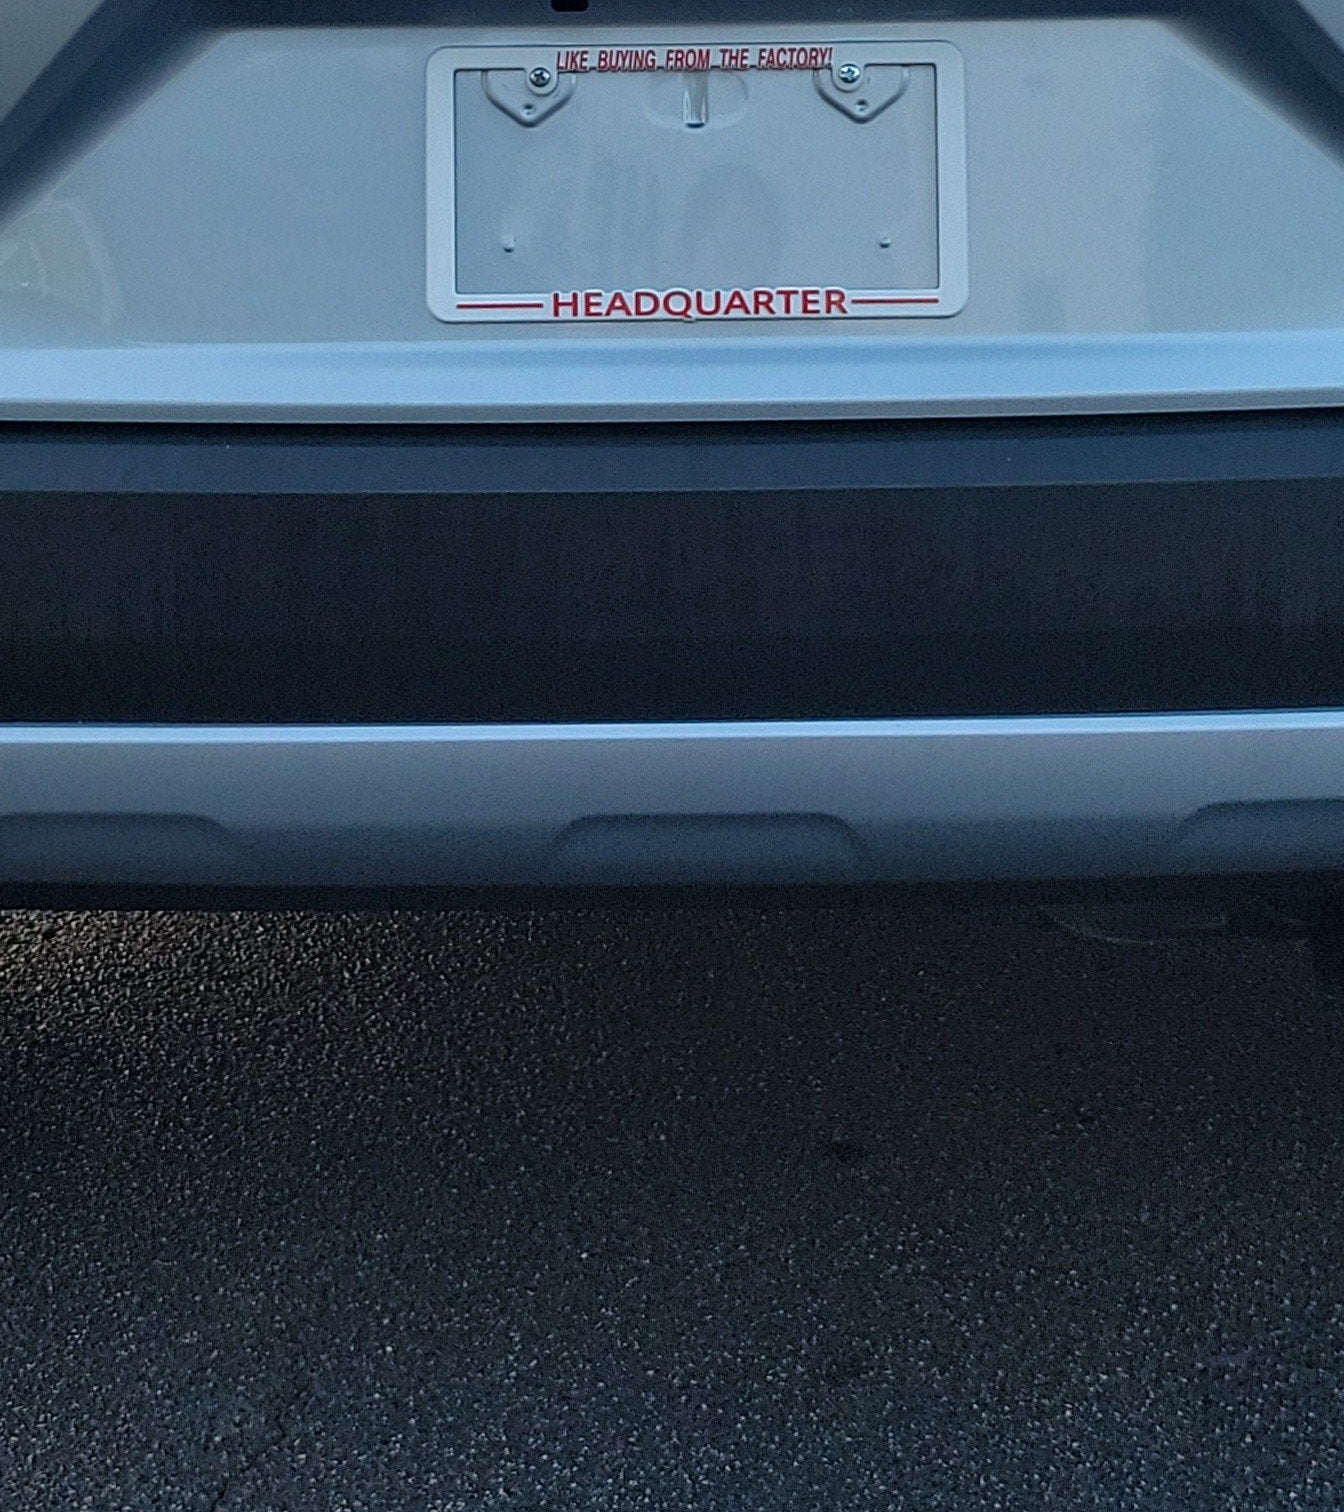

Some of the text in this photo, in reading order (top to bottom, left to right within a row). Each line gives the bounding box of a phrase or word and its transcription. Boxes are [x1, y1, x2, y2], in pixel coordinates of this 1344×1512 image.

[557, 46, 833, 71] LIKE BUYING FROM THE FACTORY!
[552, 289, 848, 319] HEADQUARTER
